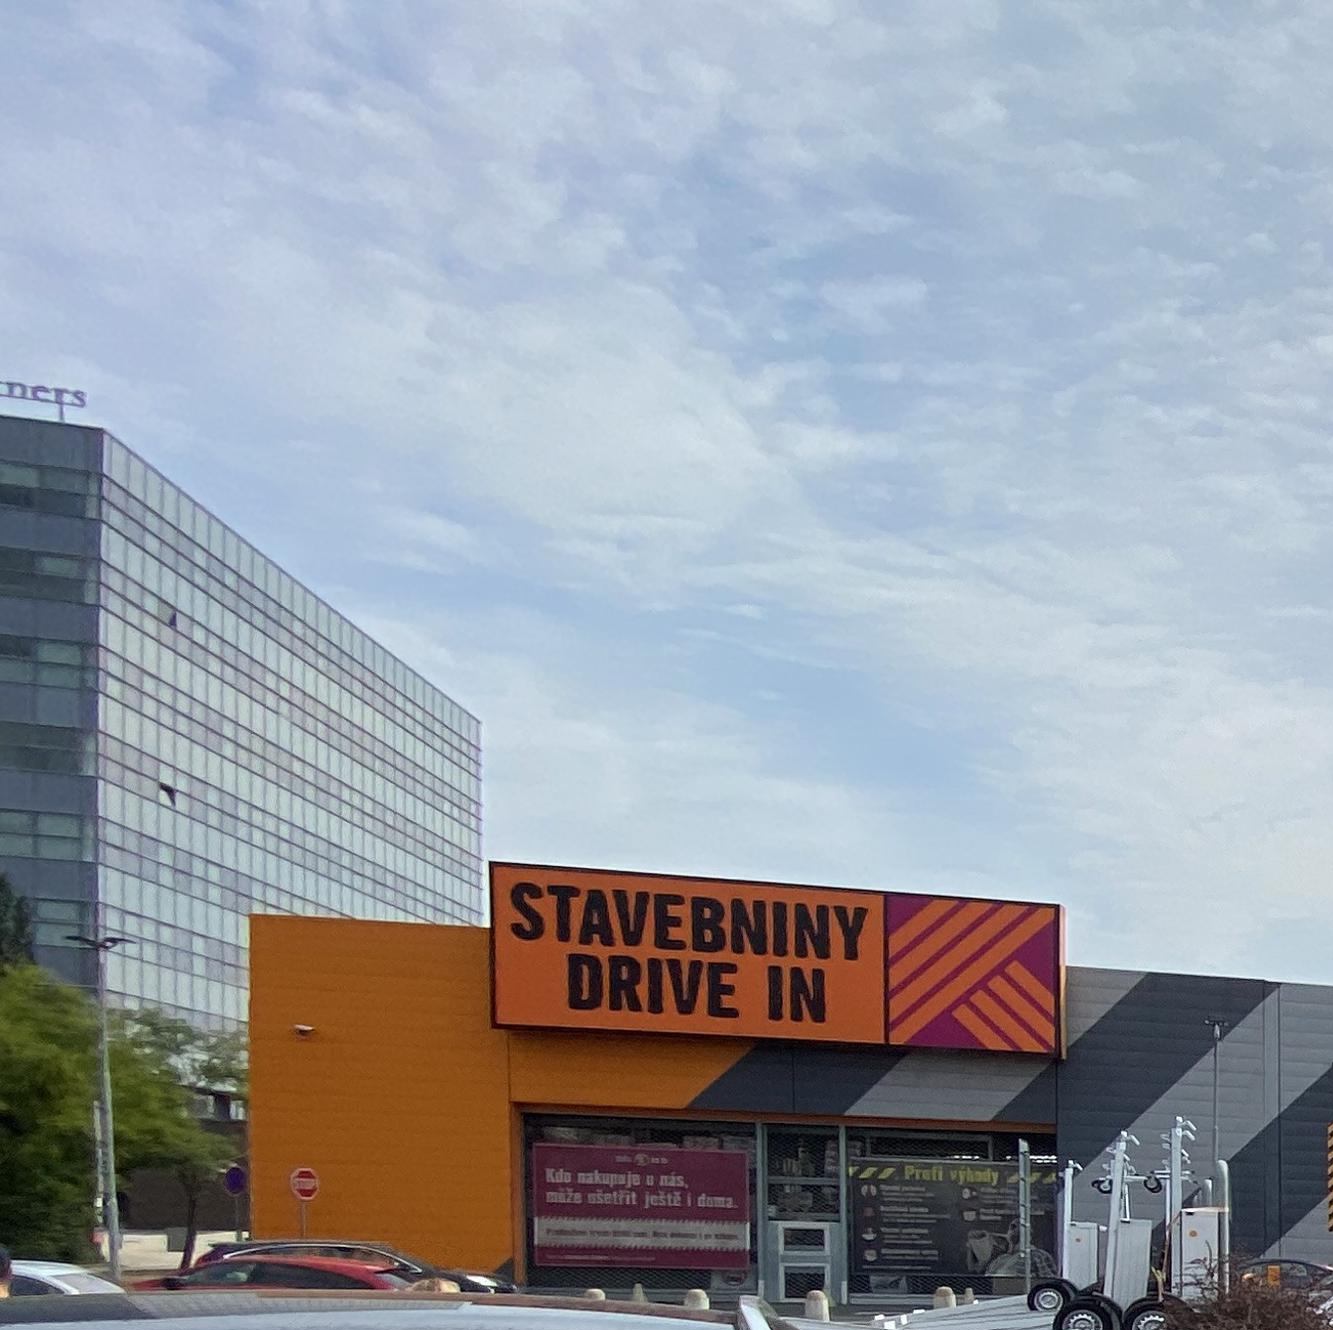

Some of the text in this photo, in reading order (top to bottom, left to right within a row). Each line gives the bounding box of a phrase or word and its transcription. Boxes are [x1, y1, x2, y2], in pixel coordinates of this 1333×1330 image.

[509, 881, 869, 961] STAVEBNINY
[567, 953, 827, 1024] DRIVE IN
[545, 1168, 572, 1184] Kdo
[577, 1169, 641, 1188] nakupuje
[904, 1165, 999, 1185] Profi výhody
